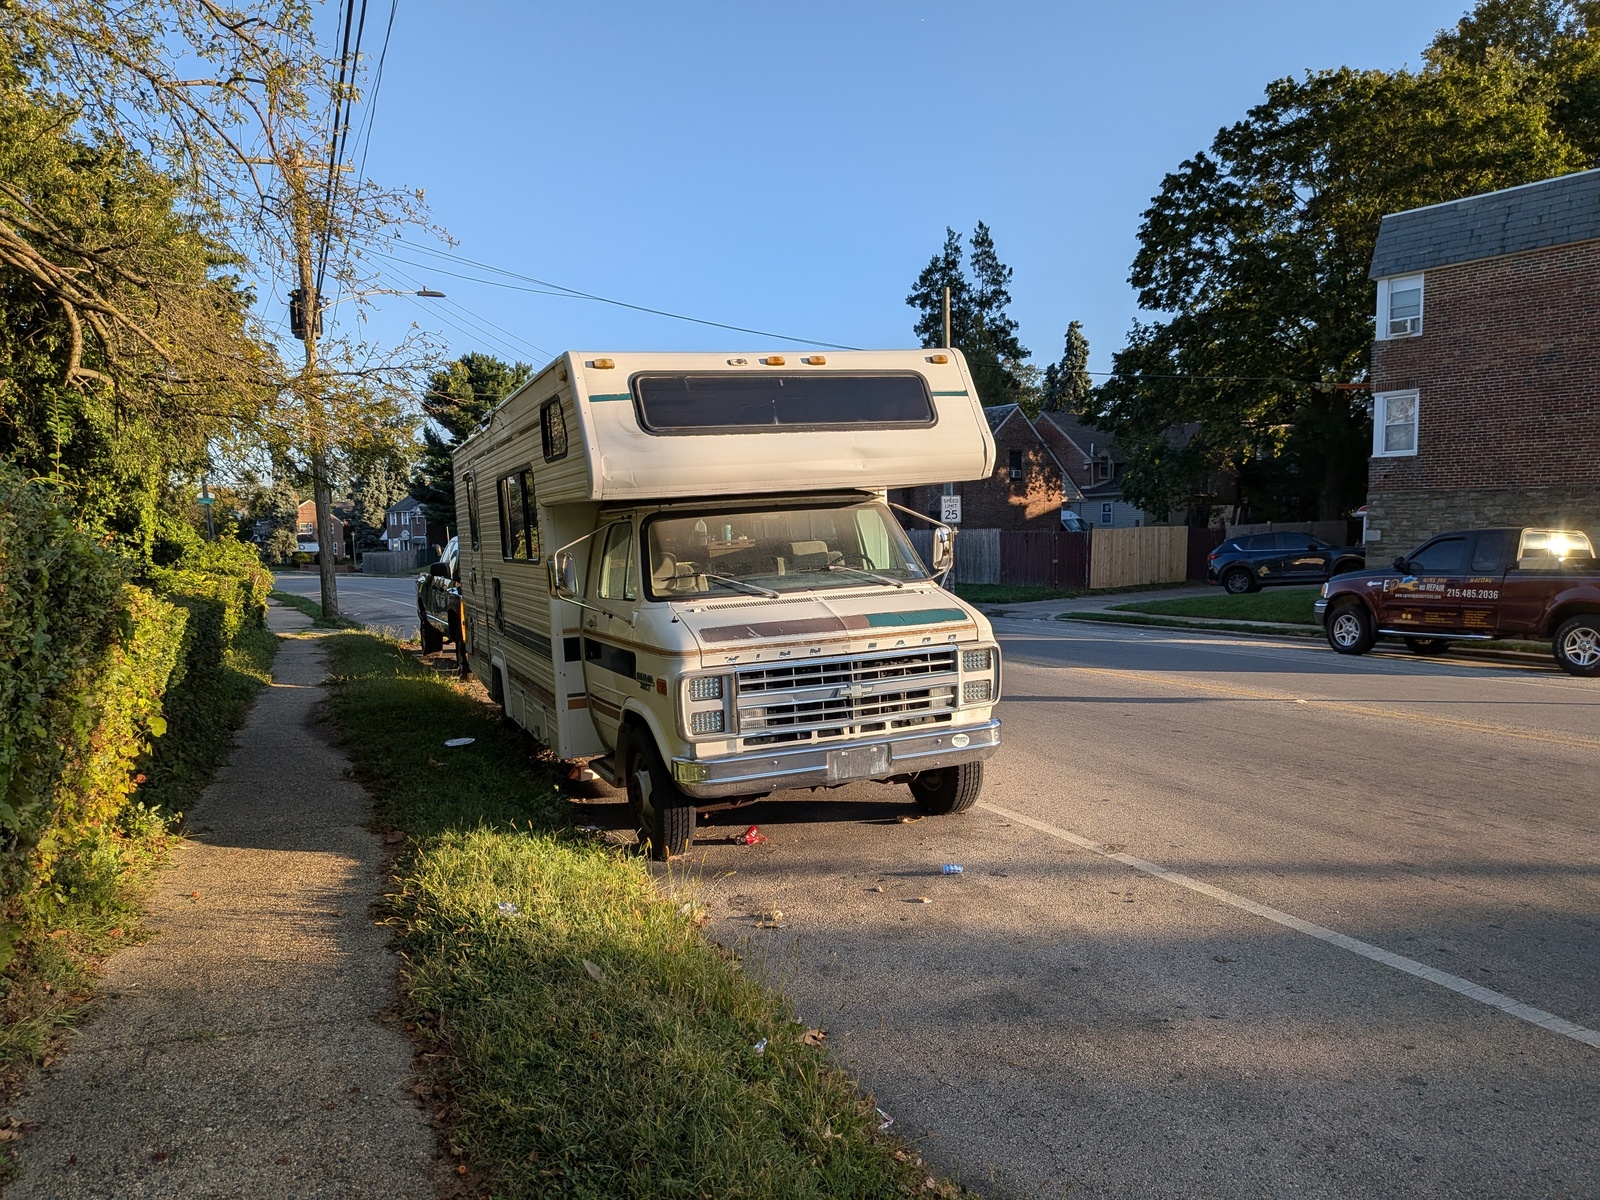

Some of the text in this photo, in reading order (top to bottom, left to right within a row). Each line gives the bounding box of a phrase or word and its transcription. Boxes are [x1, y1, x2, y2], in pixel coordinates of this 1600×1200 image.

[945, 510, 958, 519] 25
[1426, 583, 1445, 592] REPAIR
[1446, 588, 1499, 599] 215.485.2036
